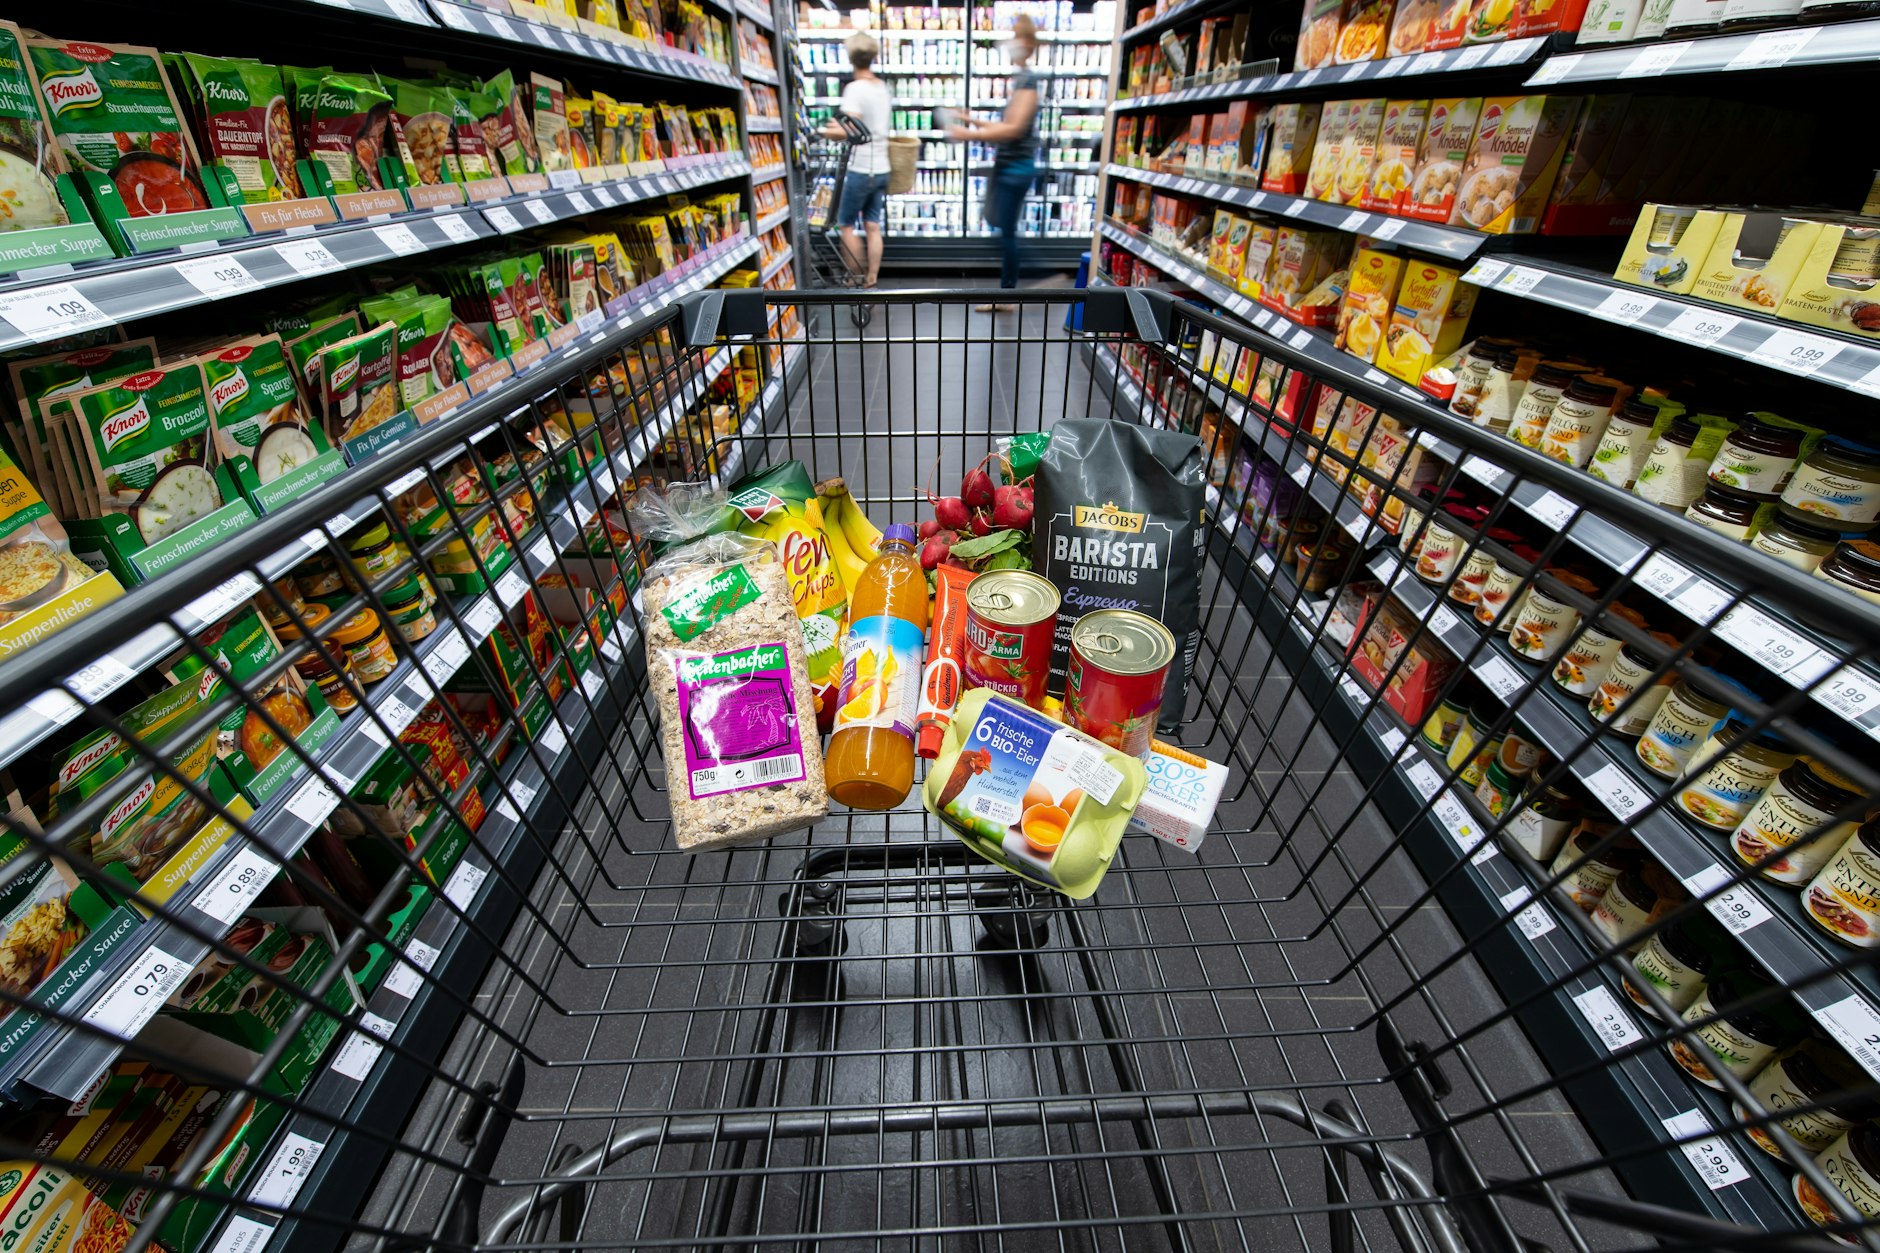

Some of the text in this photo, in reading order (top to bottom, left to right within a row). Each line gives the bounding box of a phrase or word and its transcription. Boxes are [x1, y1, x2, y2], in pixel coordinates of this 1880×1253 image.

[46, 81, 98, 104] Knorr
[109, 79, 163, 90] FEINSCHMECKER
[204, 80, 249, 103] Knorr
[105, 102, 173, 114] Strauchtomaten
[217, 129, 264, 145] BAUERNTOPF
[1391, 131, 1417, 147] Knödel
[1438, 133, 1469, 151] Knödel
[1506, 124, 1535, 137] Semmel
[1490, 135, 1529, 155] Knödel
[261, 202, 324, 224] Fix für Fleisch
[349, 200, 361, 212] Fix
[133, 217, 240, 242] Feinschmecker Suppe
[305, 250, 329, 262] 0.79
[214, 266, 243, 283] 0.99
[1706, 287, 1726, 298] PASTE
[46, 300, 87, 318] 1.09
[1620, 302, 1644, 314] 0.99
[1784, 298, 1844, 317] BRATEN-PASTE
[1694, 321, 1723, 335] 0.99
[1790, 346, 1825, 361] 0.99
[333, 361, 359, 384] Knorr
[211, 380, 248, 405] Knorr
[161, 401, 206, 431] Broccoli
[424, 403, 435, 416] Fix
[104, 408, 147, 440] Knorr
[357, 421, 408, 454] Fix für Gemüse
[1737, 461, 1762, 475] FOND
[264, 456, 341, 507] Feinschmecker Suppe
[1804, 481, 1864, 504] FISCH FOND
[4, 490, 28, 509] Suppe
[1079, 510, 1138, 530] JACOBS
[144, 508, 250, 574] Feinschmecker Suppe
[1054, 535, 1159, 571] BARISTA
[1069, 565, 1138, 586] EDITIONS
[1650, 567, 1675, 586] 1.99
[791, 571, 835, 606] Chips
[1063, 586, 1140, 611] Espresso
[0, 595, 94, 656] Suppenliebe
[988, 643, 1020, 656] PARMA
[1764, 638, 1795, 660] 1.99
[67, 663, 104, 692] 0.89
[430, 659, 447, 677] 1.79
[983, 679, 1018, 693] STÜCKIG
[1499, 678, 1515, 693] 2.99
[1831, 679, 1868, 704] 1.99
[389, 703, 406, 720] 1.79
[976, 716, 1035, 748] 6 frische
[1654, 722, 1684, 745] FOND
[1657, 708, 1697, 741] FISCH
[63, 734, 120, 782] Knorr
[990, 735, 1040, 767] BIO-Eier
[693, 770, 716, 782] 750g
[1145, 756, 1209, 793] 30%
[1708, 765, 1764, 796] FISCH
[976, 778, 1020, 799] Hühnerstall
[1611, 788, 1636, 809] 2.99
[1708, 778, 1750, 801] FOND
[104, 779, 153, 832] Knorr
[1446, 806, 1461, 822] 0.59
[164, 821, 230, 888] Suppenliebe
[26, 861, 47, 885] Sauce
[229, 866, 257, 894] 0.89
[463, 866, 478, 884] 1.29
[1833, 876, 1878, 909] FOND
[1721, 893, 1752, 920] 2.99
[1524, 908, 1542, 929] 2.99
[93, 917, 132, 958] Sauce
[134, 963, 168, 997] 0.79
[98, 978, 128, 1010] CHAMPIGNON
[1603, 1014, 1627, 1038] 2.99
[281, 1147, 306, 1178] 1.99
[1701, 1144, 1729, 1175] 2.99
[1, 1170, 62, 1252] acoli
